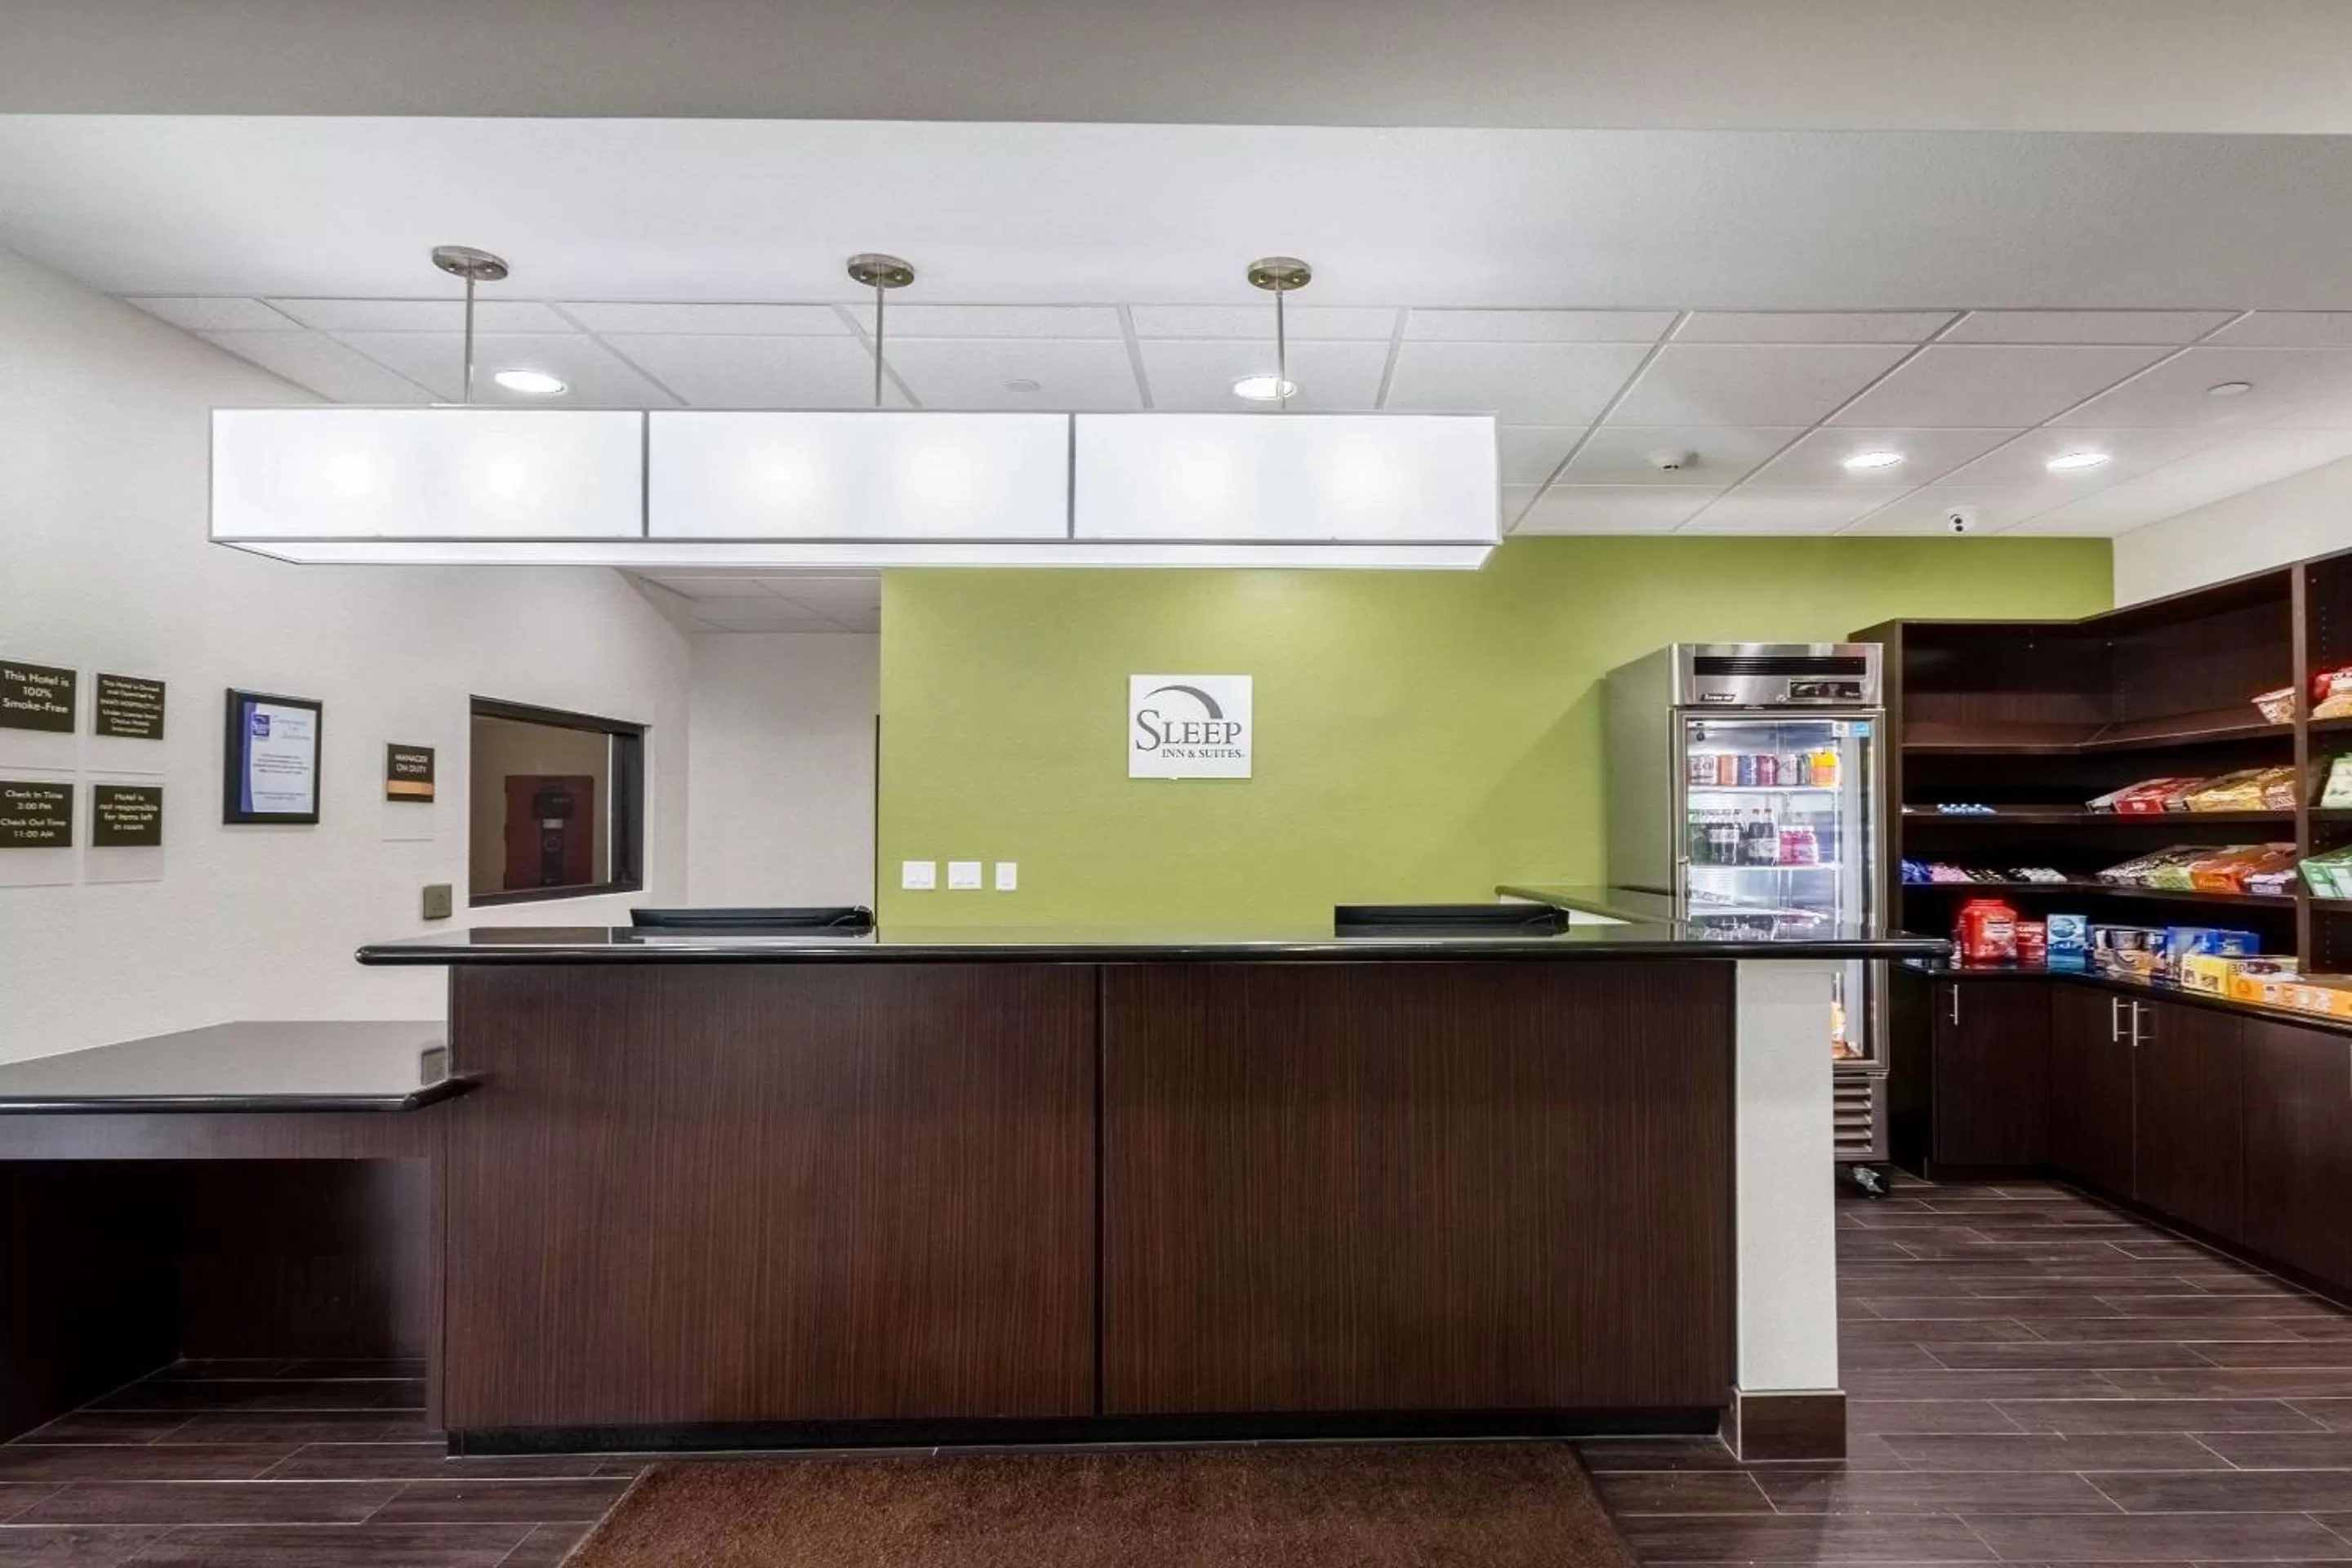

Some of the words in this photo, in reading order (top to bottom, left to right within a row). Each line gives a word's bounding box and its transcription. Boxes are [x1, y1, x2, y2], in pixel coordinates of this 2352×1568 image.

[4, 669, 26, 681] This
[29, 673, 58, 685] Hotel
[60, 677, 69, 688] is
[23, 686, 52, 698] 100%
[2, 697, 69, 713] Smoke-Free
[1135, 709, 1242, 751] SLEEP
[1161, 749, 1185, 758] INN
[1187, 749, 1196, 758] &
[1199, 749, 1241, 758] SUITES
[396, 763, 408, 773] ON
[5, 790, 32, 799] Check
[43, 791, 63, 800] Time
[114, 793, 136, 801] Hotel
[114, 804, 158, 812] responsible
[0, 817, 26, 826] Check
[29, 818, 45, 826] Out
[47, 818, 67, 826] Time
[104, 813, 117, 821] for
[140, 813, 154, 821] left
